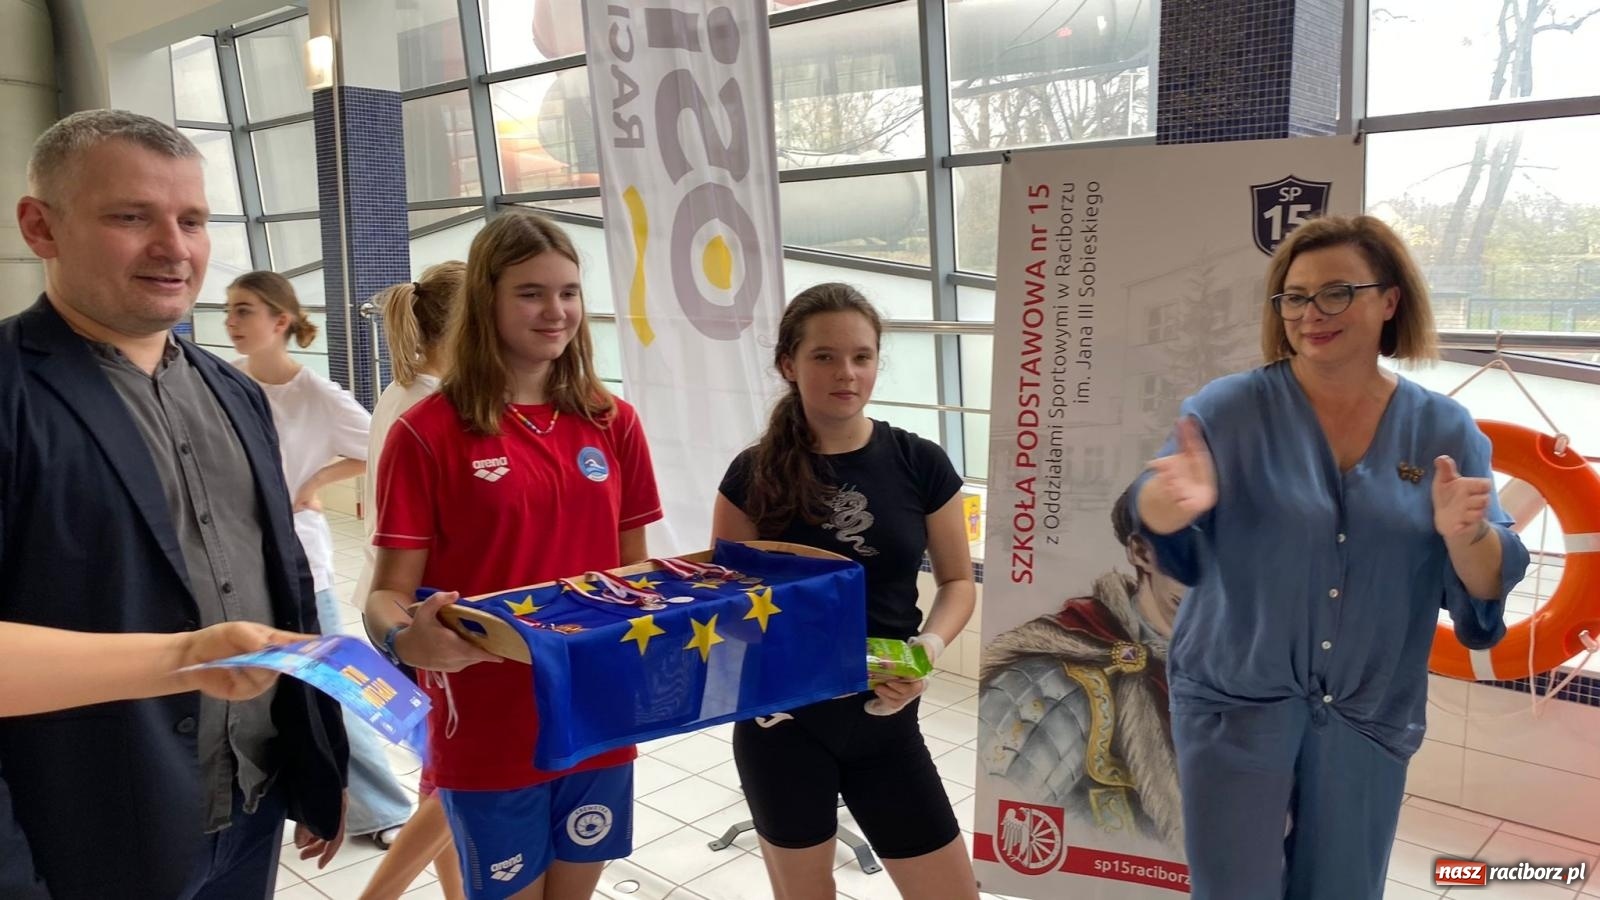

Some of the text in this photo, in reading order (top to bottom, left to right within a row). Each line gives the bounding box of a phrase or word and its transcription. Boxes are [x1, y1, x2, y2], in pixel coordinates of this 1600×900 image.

[1278, 187, 1303, 202] SP
[1263, 203, 1312, 241] 15
[1073, 180, 1104, 404] im. Jana III Sobieskiego
[1043, 182, 1076, 545] z Oddziałami Sportowymi w Raciborzu
[1011, 183, 1050, 585] SZKOŁA PODSTAWOWA nr 15
[471, 456, 509, 470] arena
[490, 852, 523, 873] arena
[1094, 858, 1191, 885] sp15raciborz
